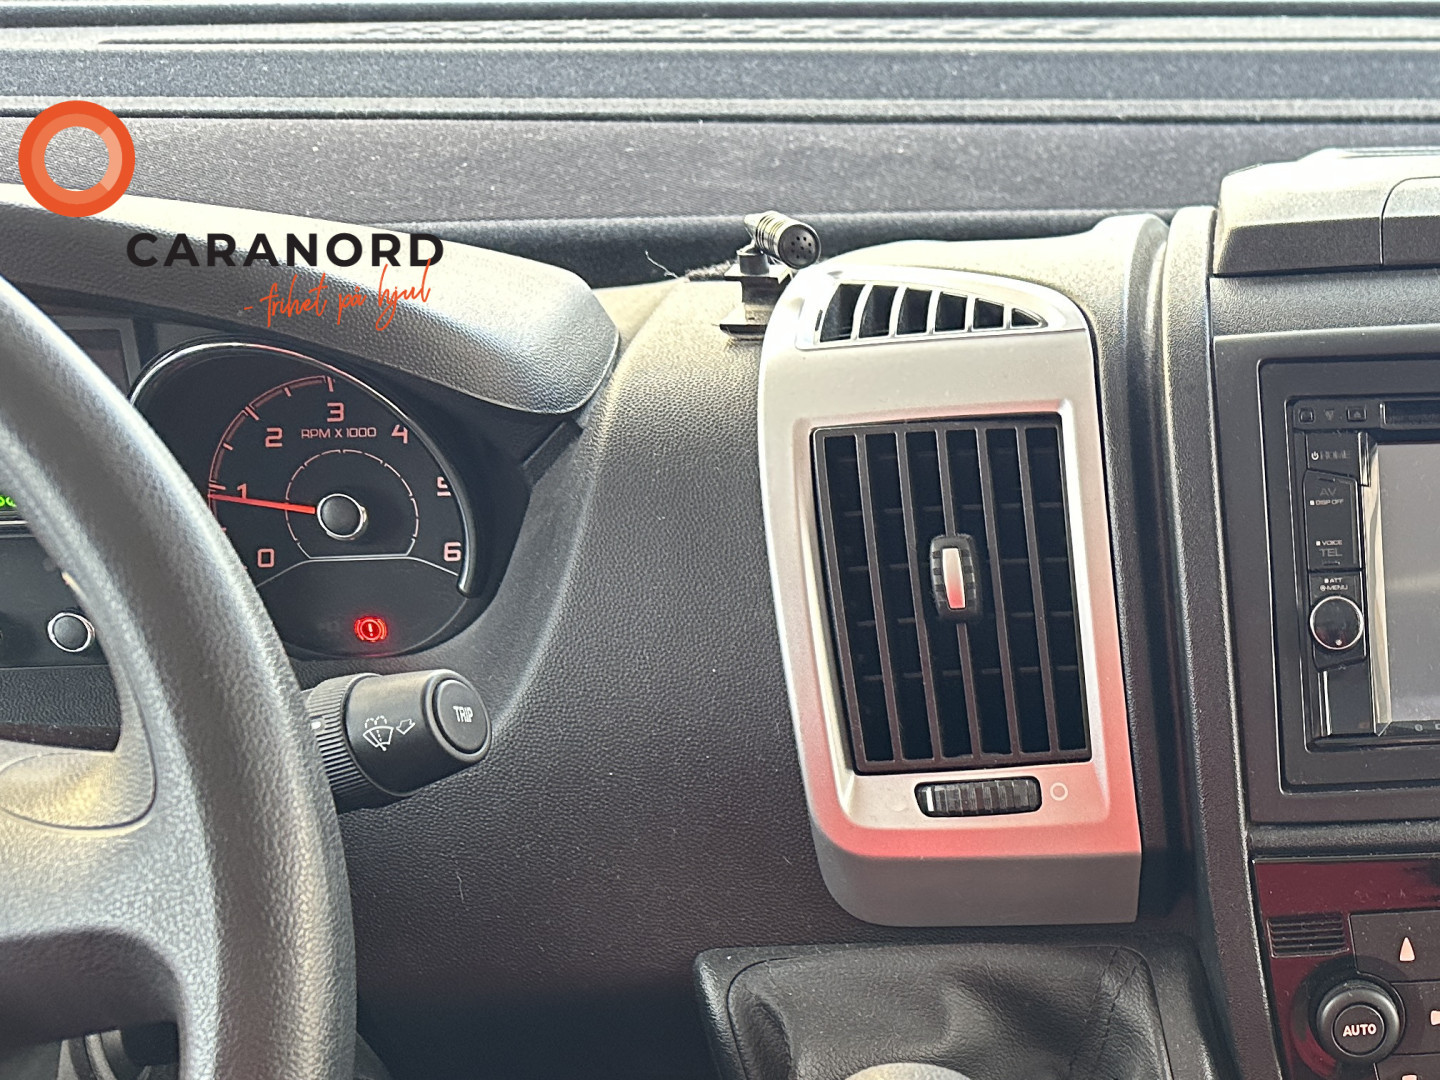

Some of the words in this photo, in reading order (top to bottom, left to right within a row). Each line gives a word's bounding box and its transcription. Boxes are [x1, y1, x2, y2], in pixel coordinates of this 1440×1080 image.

[327, 402, 345, 422] 3
[265, 427, 283, 448] 2
[301, 428, 331, 439] RPM
[334, 428, 343, 438] X
[346, 427, 377, 438] 1000
[391, 424, 409, 444] 4
[237, 483, 247, 499] 1
[1320, 488, 1337, 496] AV
[257, 548, 275, 568] 0
[443, 542, 462, 562] 6
[1320, 549, 1343, 557] TEL
[1342, 1023, 1377, 1037] AUTO
